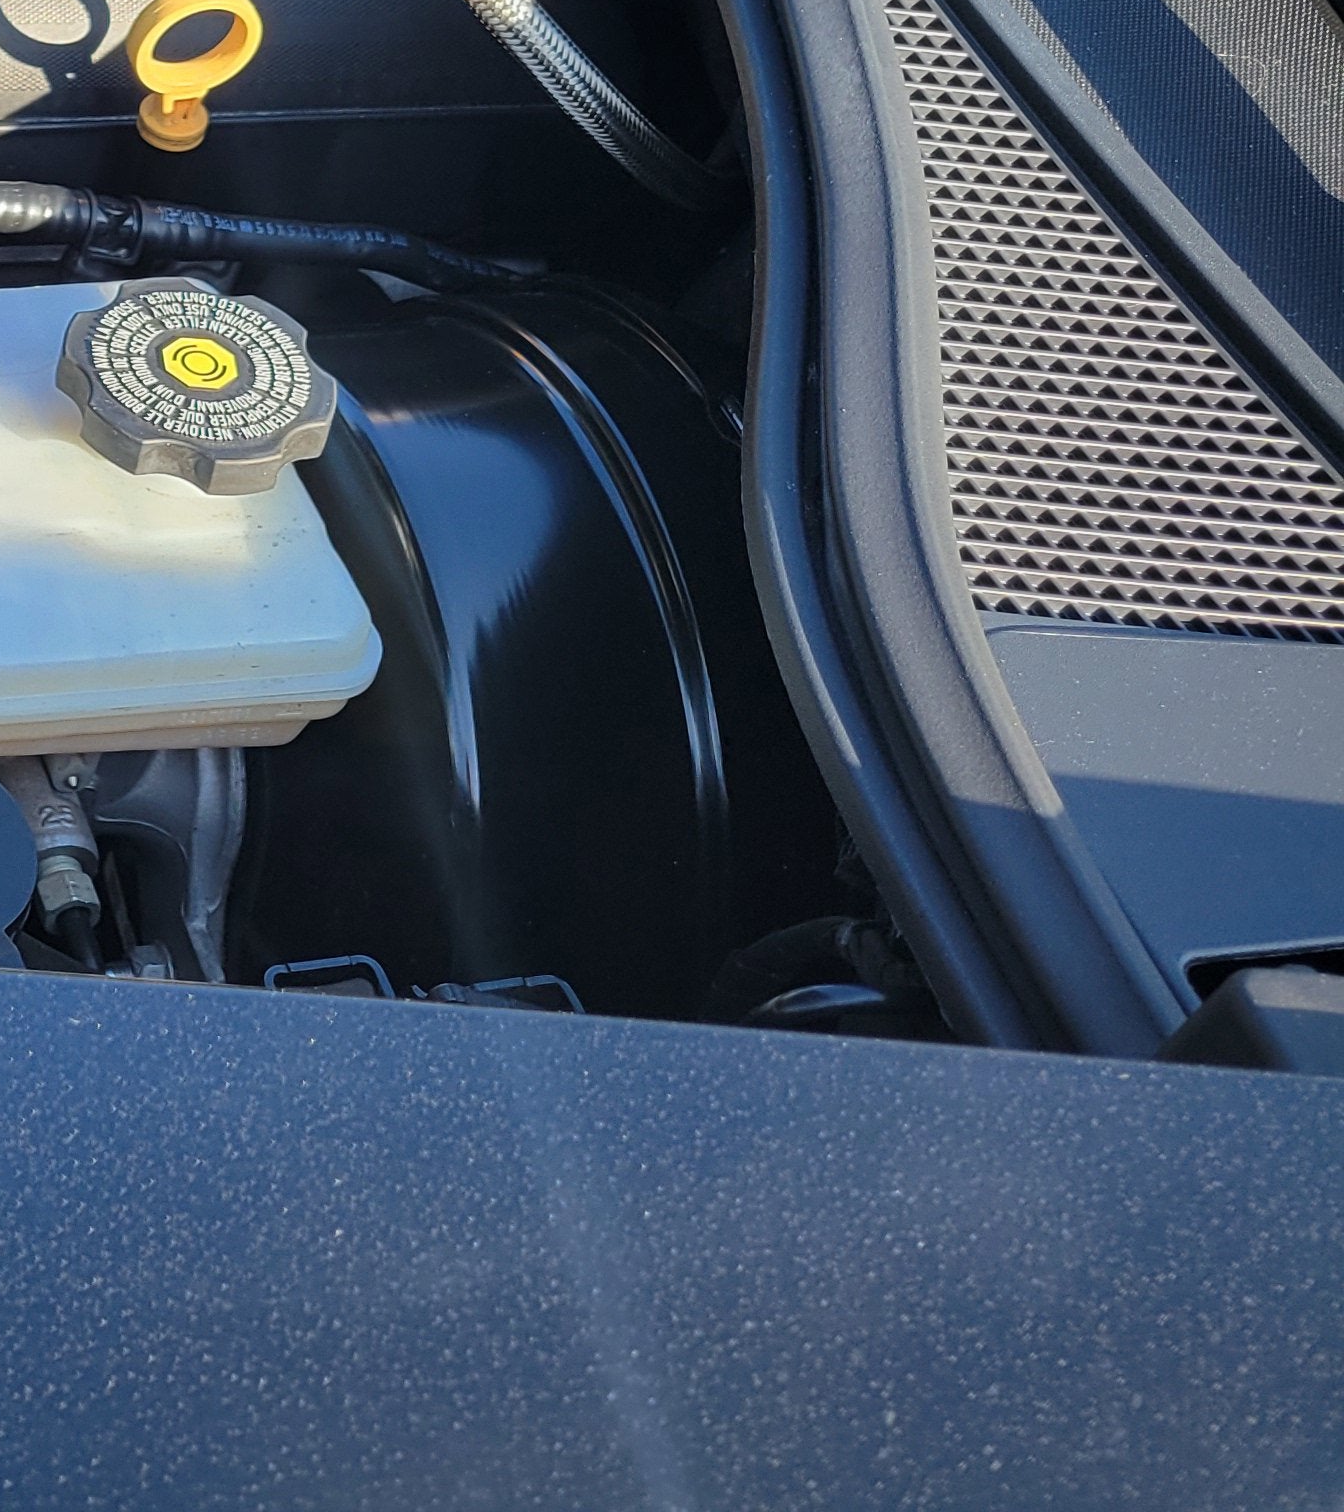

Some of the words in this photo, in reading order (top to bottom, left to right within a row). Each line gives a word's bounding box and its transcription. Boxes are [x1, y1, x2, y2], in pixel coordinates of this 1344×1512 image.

[121, 311, 153, 331] DOT4
[150, 303, 184, 318] ONLY
[183, 303, 209, 317] USE
[218, 298, 267, 326] SEALED
[94, 327, 112, 340] LA
[161, 315, 208, 329] FILLER
[209, 319, 252, 346] CLEAN
[261, 320, 278, 332] A
[110, 328, 133, 355] FREIN
[268, 328, 302, 356] FROM
[91, 340, 112, 369] AVANT
[111, 356, 130, 369] DE
[264, 345, 292, 382] BEFORE
[130, 356, 160, 386] BIDON
[288, 355, 312, 383] FLUID
[99, 371, 146, 414] BOUCHON
[116, 370, 157, 405] LIQUIDE
[152, 384, 187, 406] D'UN
[269, 381, 290, 401] CAP
[288, 383, 312, 408] DOT4
[154, 400, 176, 416] DU
[188, 390, 263, 413] PROVENANT
[143, 409, 165, 425] LE
[177, 408, 205, 425] QUE
[163, 417, 233, 441] NETTOYER
